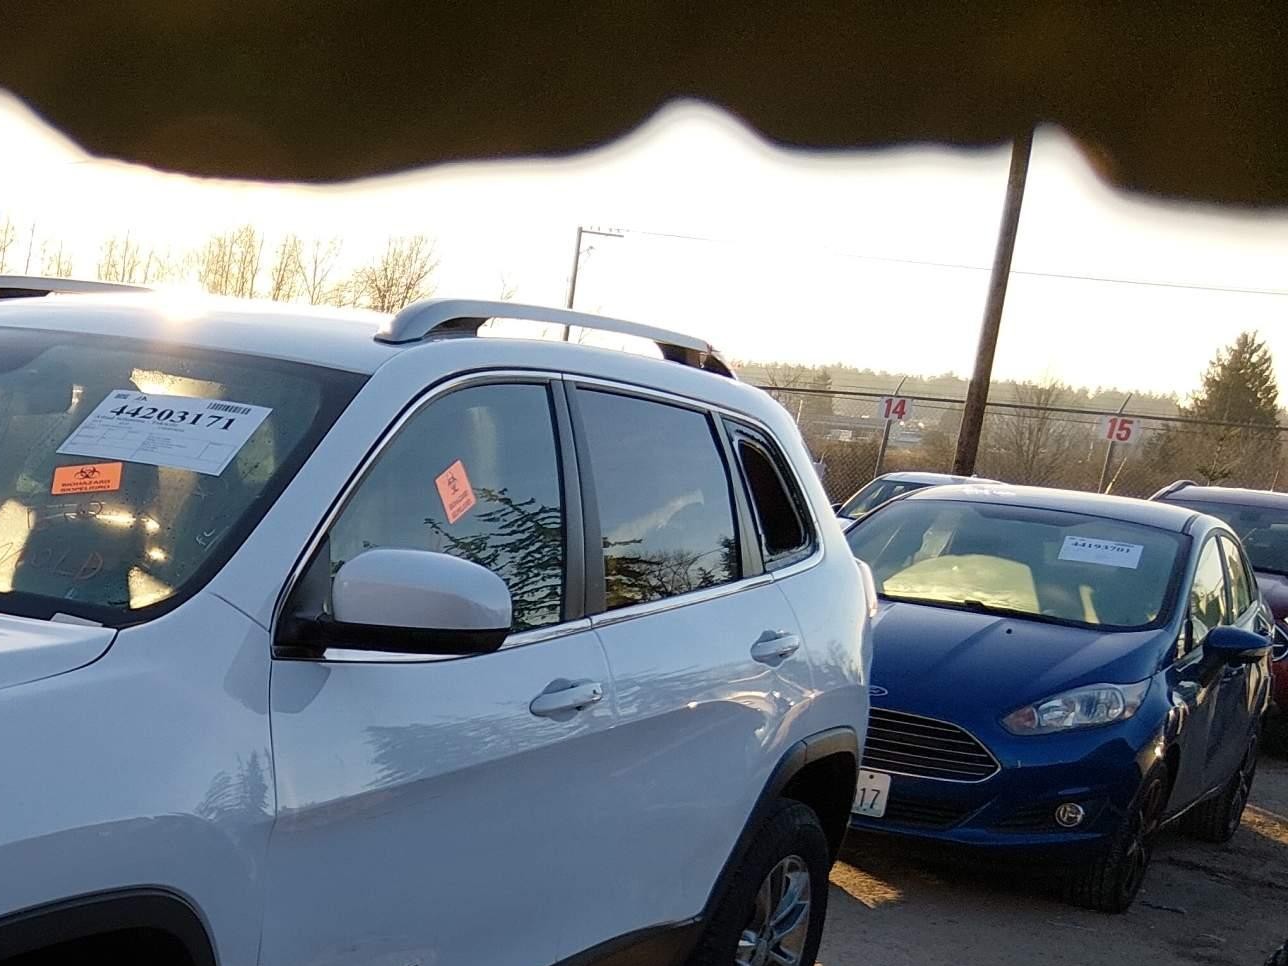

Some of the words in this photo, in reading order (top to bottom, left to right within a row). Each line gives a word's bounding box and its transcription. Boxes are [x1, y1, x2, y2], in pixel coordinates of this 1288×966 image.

[110, 404, 236, 431] 44203171
[883, 398, 907, 420] 14
[1105, 418, 1134, 442] 15
[860, 787, 881, 809] 17
